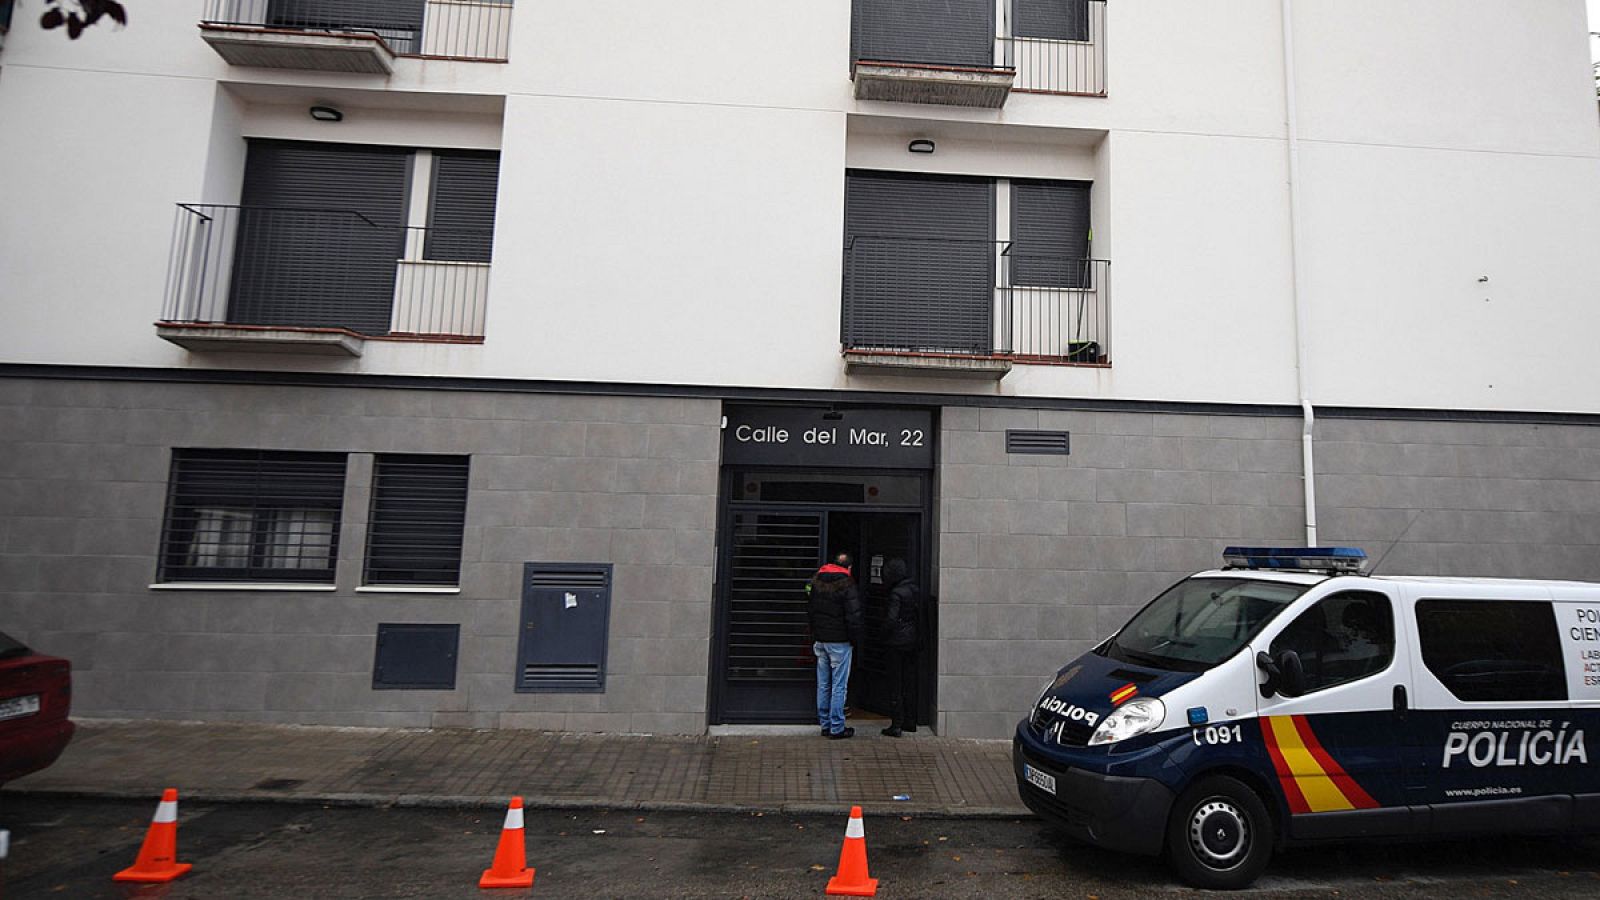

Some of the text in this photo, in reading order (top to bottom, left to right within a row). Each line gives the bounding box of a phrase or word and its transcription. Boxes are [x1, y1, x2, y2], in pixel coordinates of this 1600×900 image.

[735, 425, 924, 447] Calle del Mar, 22
[1205, 724, 1242, 745] 091
[1452, 719, 1553, 729] CUERPO NACIONAL DE
[1442, 721, 1588, 768] POLICÍA
[1445, 786, 1522, 796] www.policia.es
